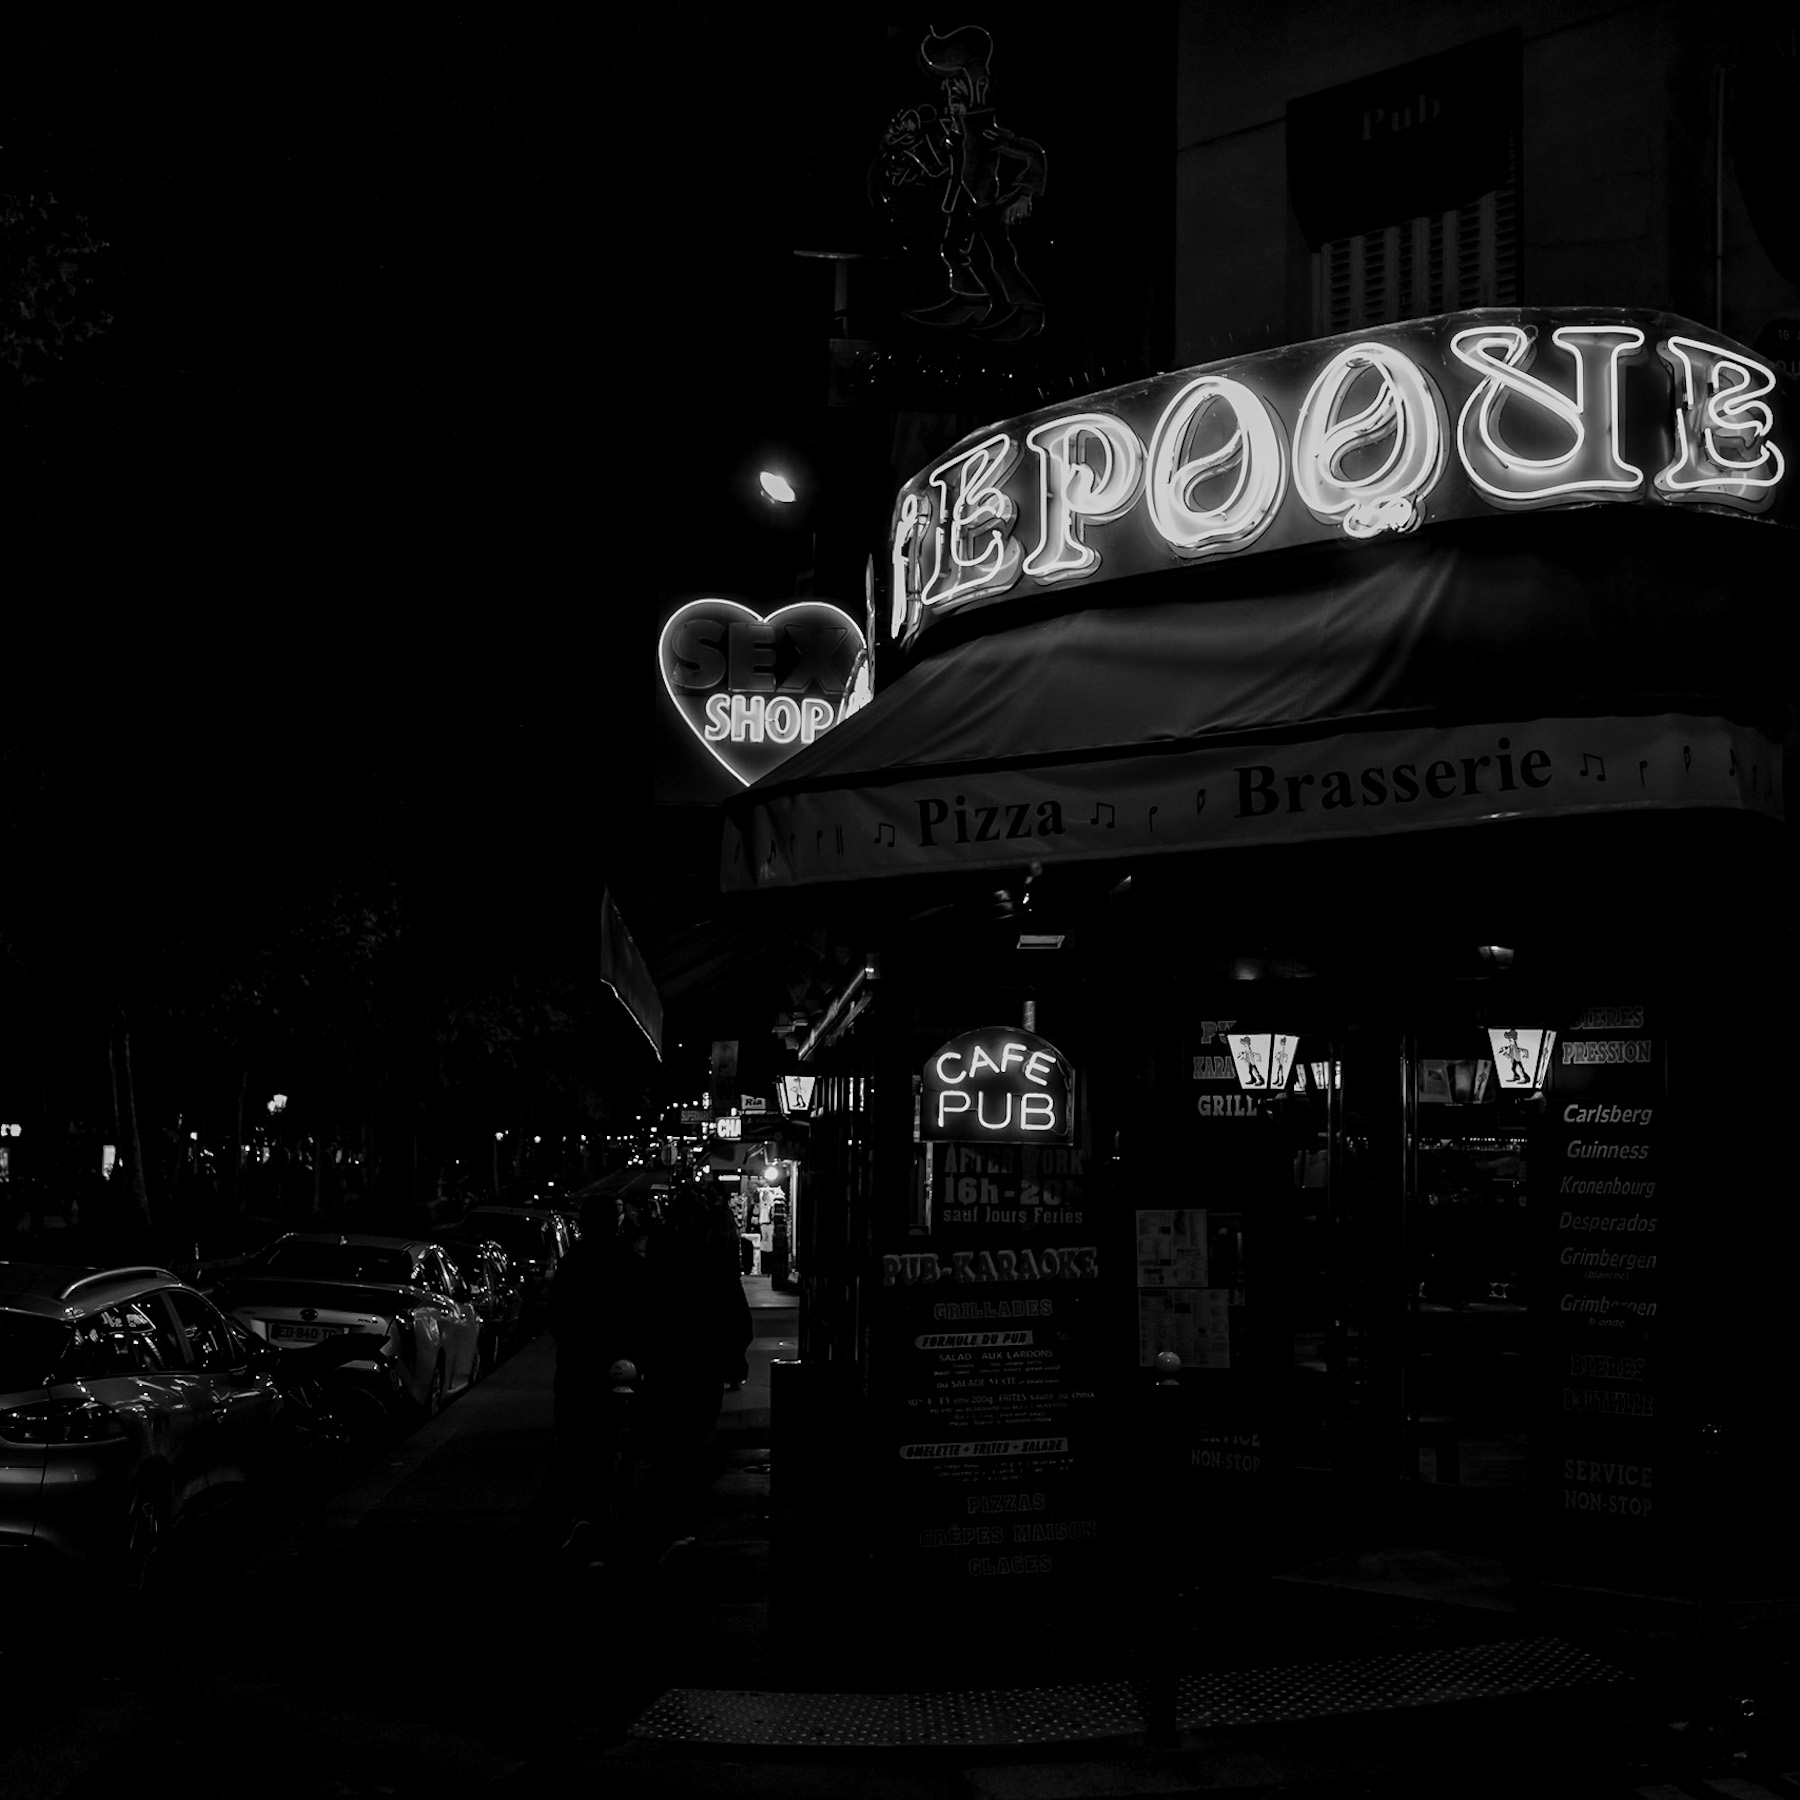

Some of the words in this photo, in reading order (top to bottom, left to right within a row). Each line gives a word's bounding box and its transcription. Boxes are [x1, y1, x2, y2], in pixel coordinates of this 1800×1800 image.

[1360, 93, 1443, 141] Pub
[672, 618, 848, 694] SEX
[704, 693, 834, 744] SHOP
[1234, 738, 1552, 818] Brasserie
[914, 796, 1065, 847] Pizza
[1569, 1004, 1644, 1030] IERES
[936, 1042, 1057, 1086] CAFE
[1562, 1039, 1651, 1065] PRESSION
[937, 1090, 1056, 1131] PUB
[1562, 1103, 1654, 1126] Carlsberg
[1566, 1139, 1650, 1160] Guinness
[1560, 1175, 1657, 1199] Kronenbourg
[943, 1205, 979, 1223] sauf
[1558, 1210, 1657, 1233] Desperados
[881, 1246, 1099, 1288] PUB-KARAOKE
[1560, 1246, 1657, 1271] Grimbergen
[933, 1299, 1053, 1321] GRILLADES
[1588, 1316, 1626, 1328] bonde
[922, 1335, 978, 1348] FORMULE
[981, 1334, 999, 1346] DU
[1002, 1333, 1027, 1344] PUB
[938, 1351, 974, 1363] SALAD
[981, 1351, 1003, 1361] AUX
[1006, 1349, 1054, 1360] LARDONS
[907, 1444, 961, 1458] OMELETTE
[973, 1442, 1010, 1455] FRITES
[1022, 1439, 1063, 1452] SALADE
[1563, 1458, 1653, 1489] SERVICE
[966, 1492, 1046, 1515] PIZZAS
[1563, 1488, 1652, 1519] NON-STOP
[1012, 1520, 1097, 1543] MAISON
[967, 1553, 1053, 1577] GLACES
